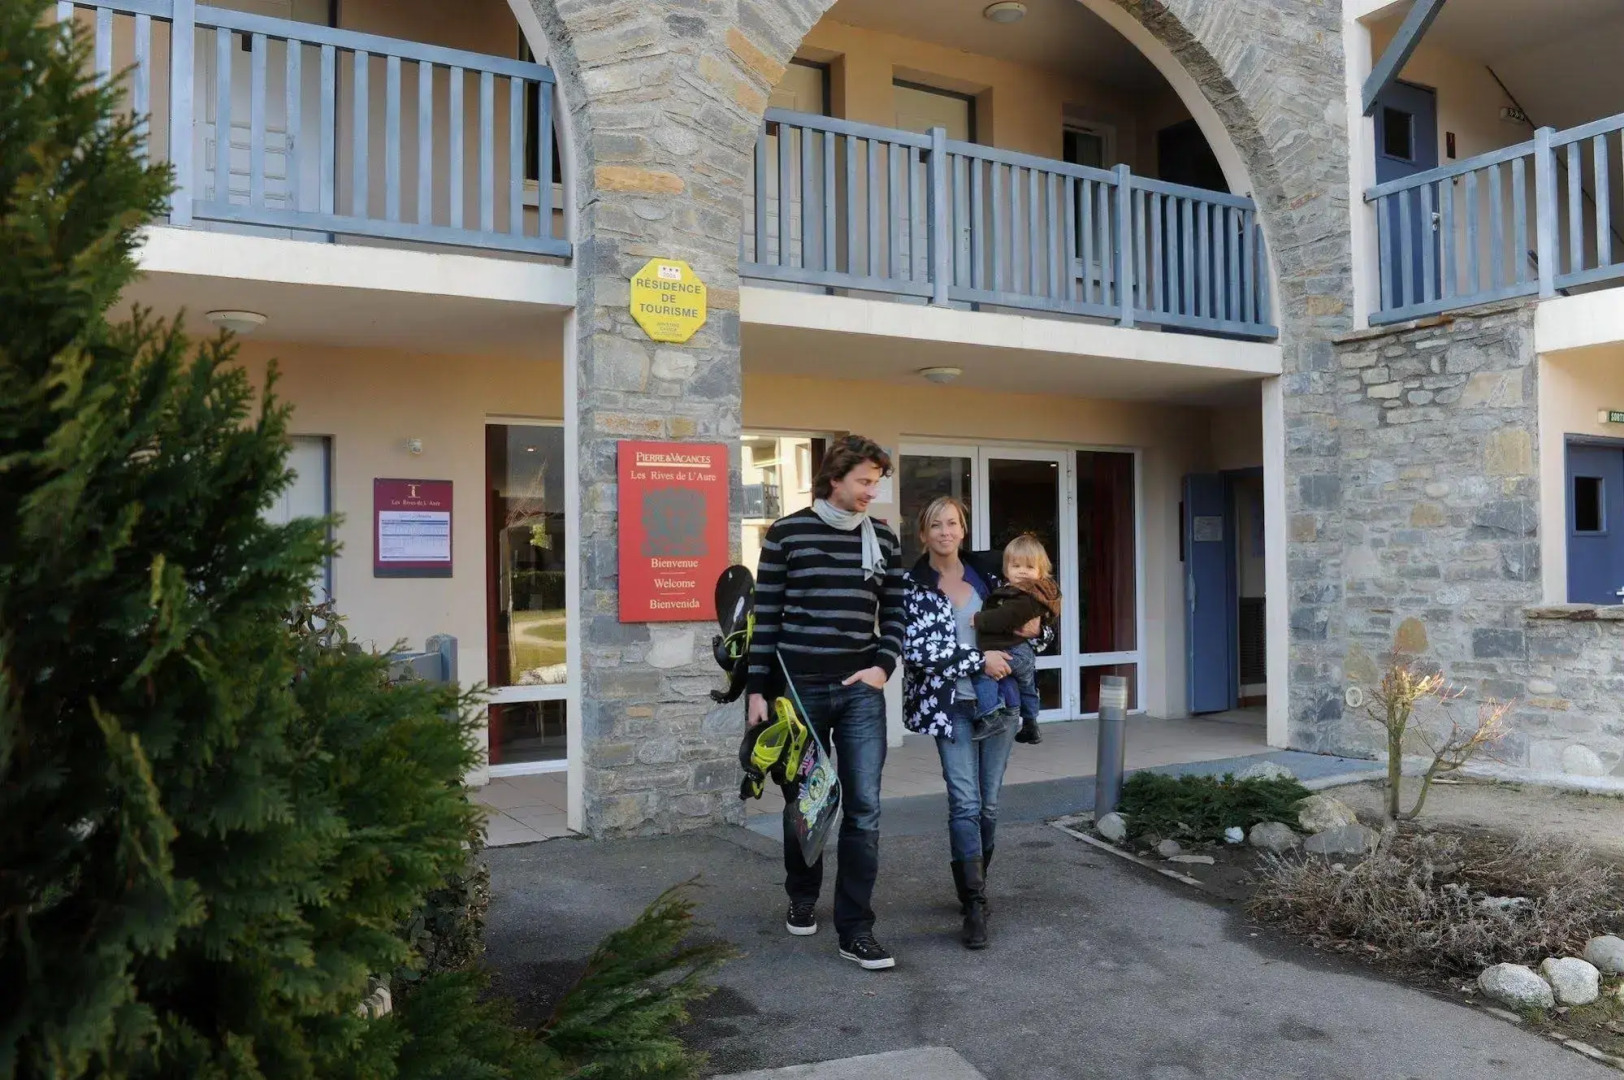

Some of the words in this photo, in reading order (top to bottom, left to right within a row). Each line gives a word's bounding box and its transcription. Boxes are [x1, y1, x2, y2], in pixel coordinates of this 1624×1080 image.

[636, 278, 701, 294] RÉSIDENCE
[661, 294, 676, 303] DE
[640, 304, 698, 318] TOURISME
[630, 470, 646, 480] Les
[651, 471, 674, 480] Rives
[676, 471, 686, 481] de
[650, 558, 699, 568] Bienvenue
[654, 579, 695, 588] Welcome
[650, 599, 700, 609] Bienvenida
